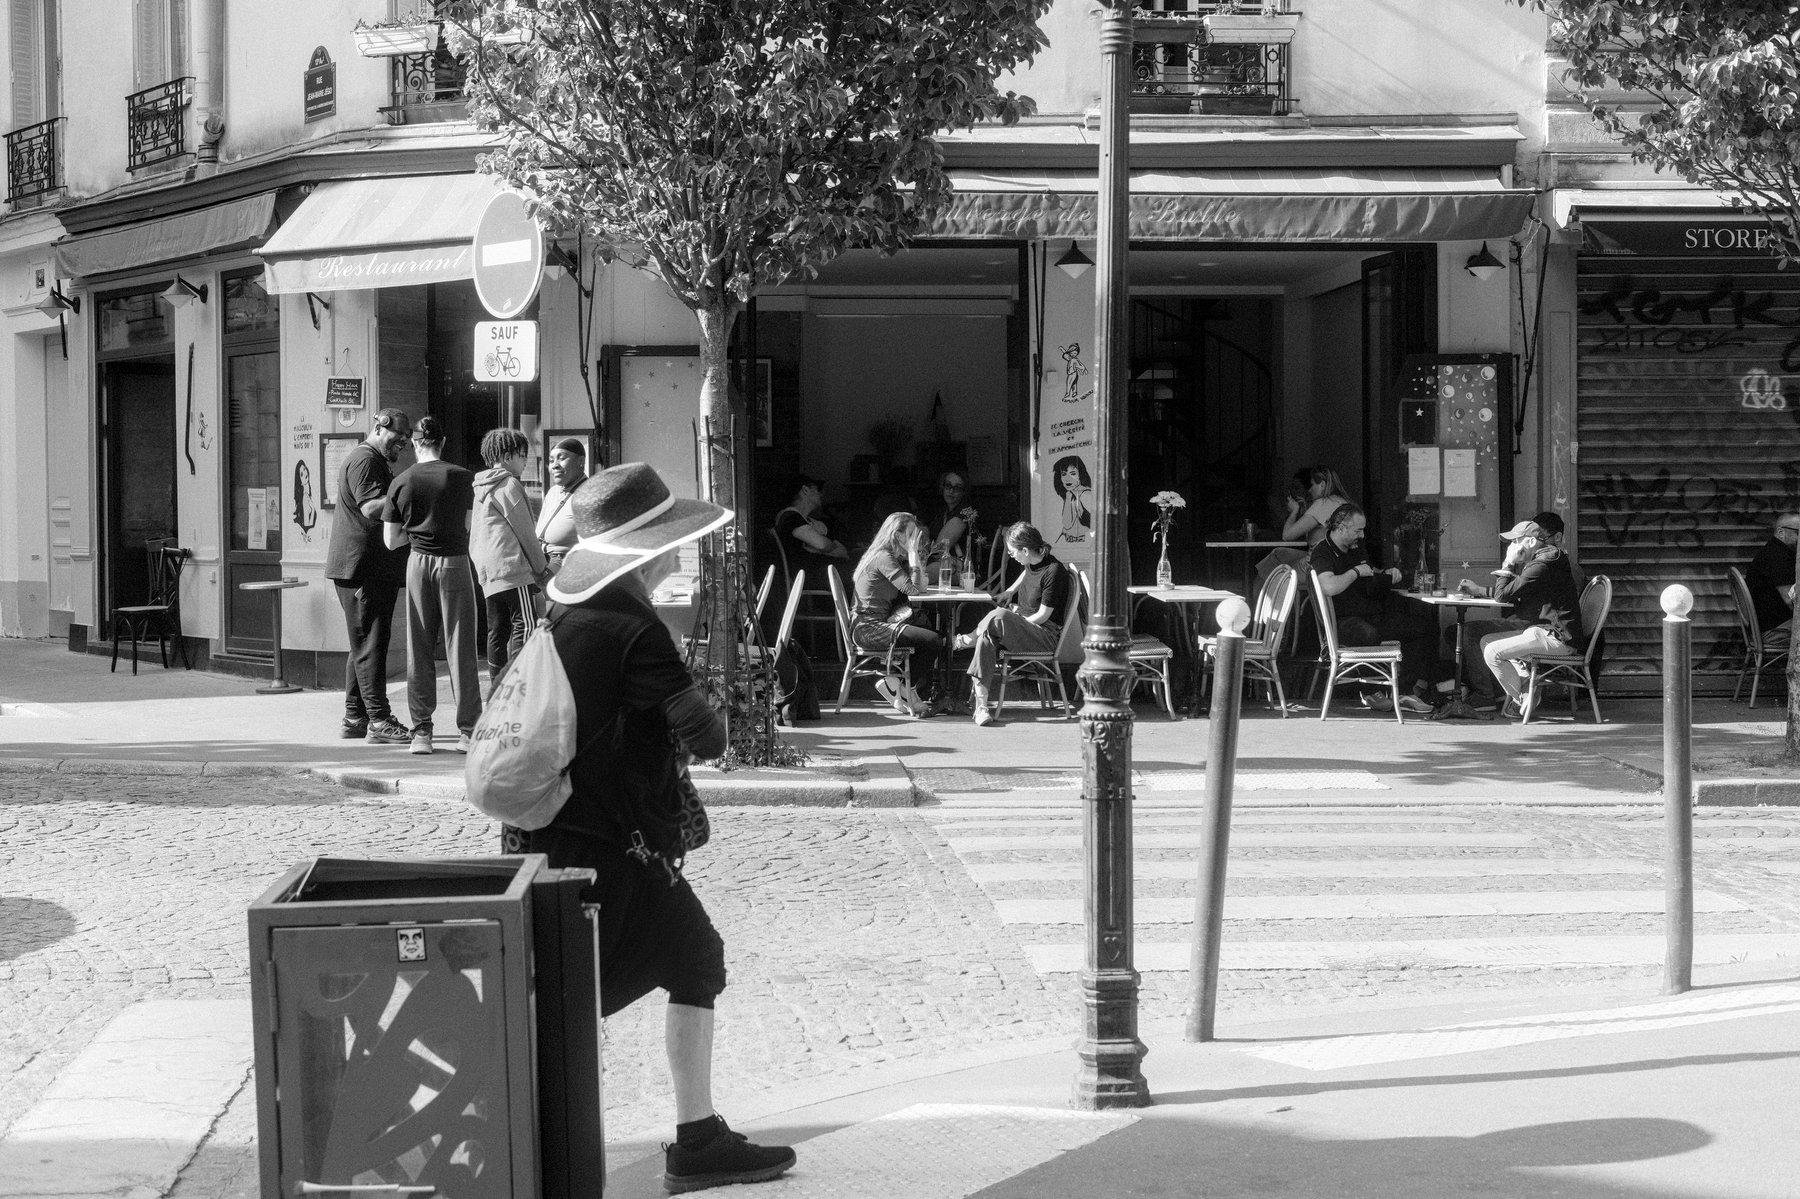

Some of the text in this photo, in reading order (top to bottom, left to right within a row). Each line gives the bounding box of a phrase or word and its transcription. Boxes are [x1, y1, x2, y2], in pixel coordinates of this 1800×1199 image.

[936, 196, 1095, 236] uberge de
[1685, 228, 1778, 249] STORE
[318, 248, 469, 279] Restaurant
[491, 326, 519, 340] SAUF
